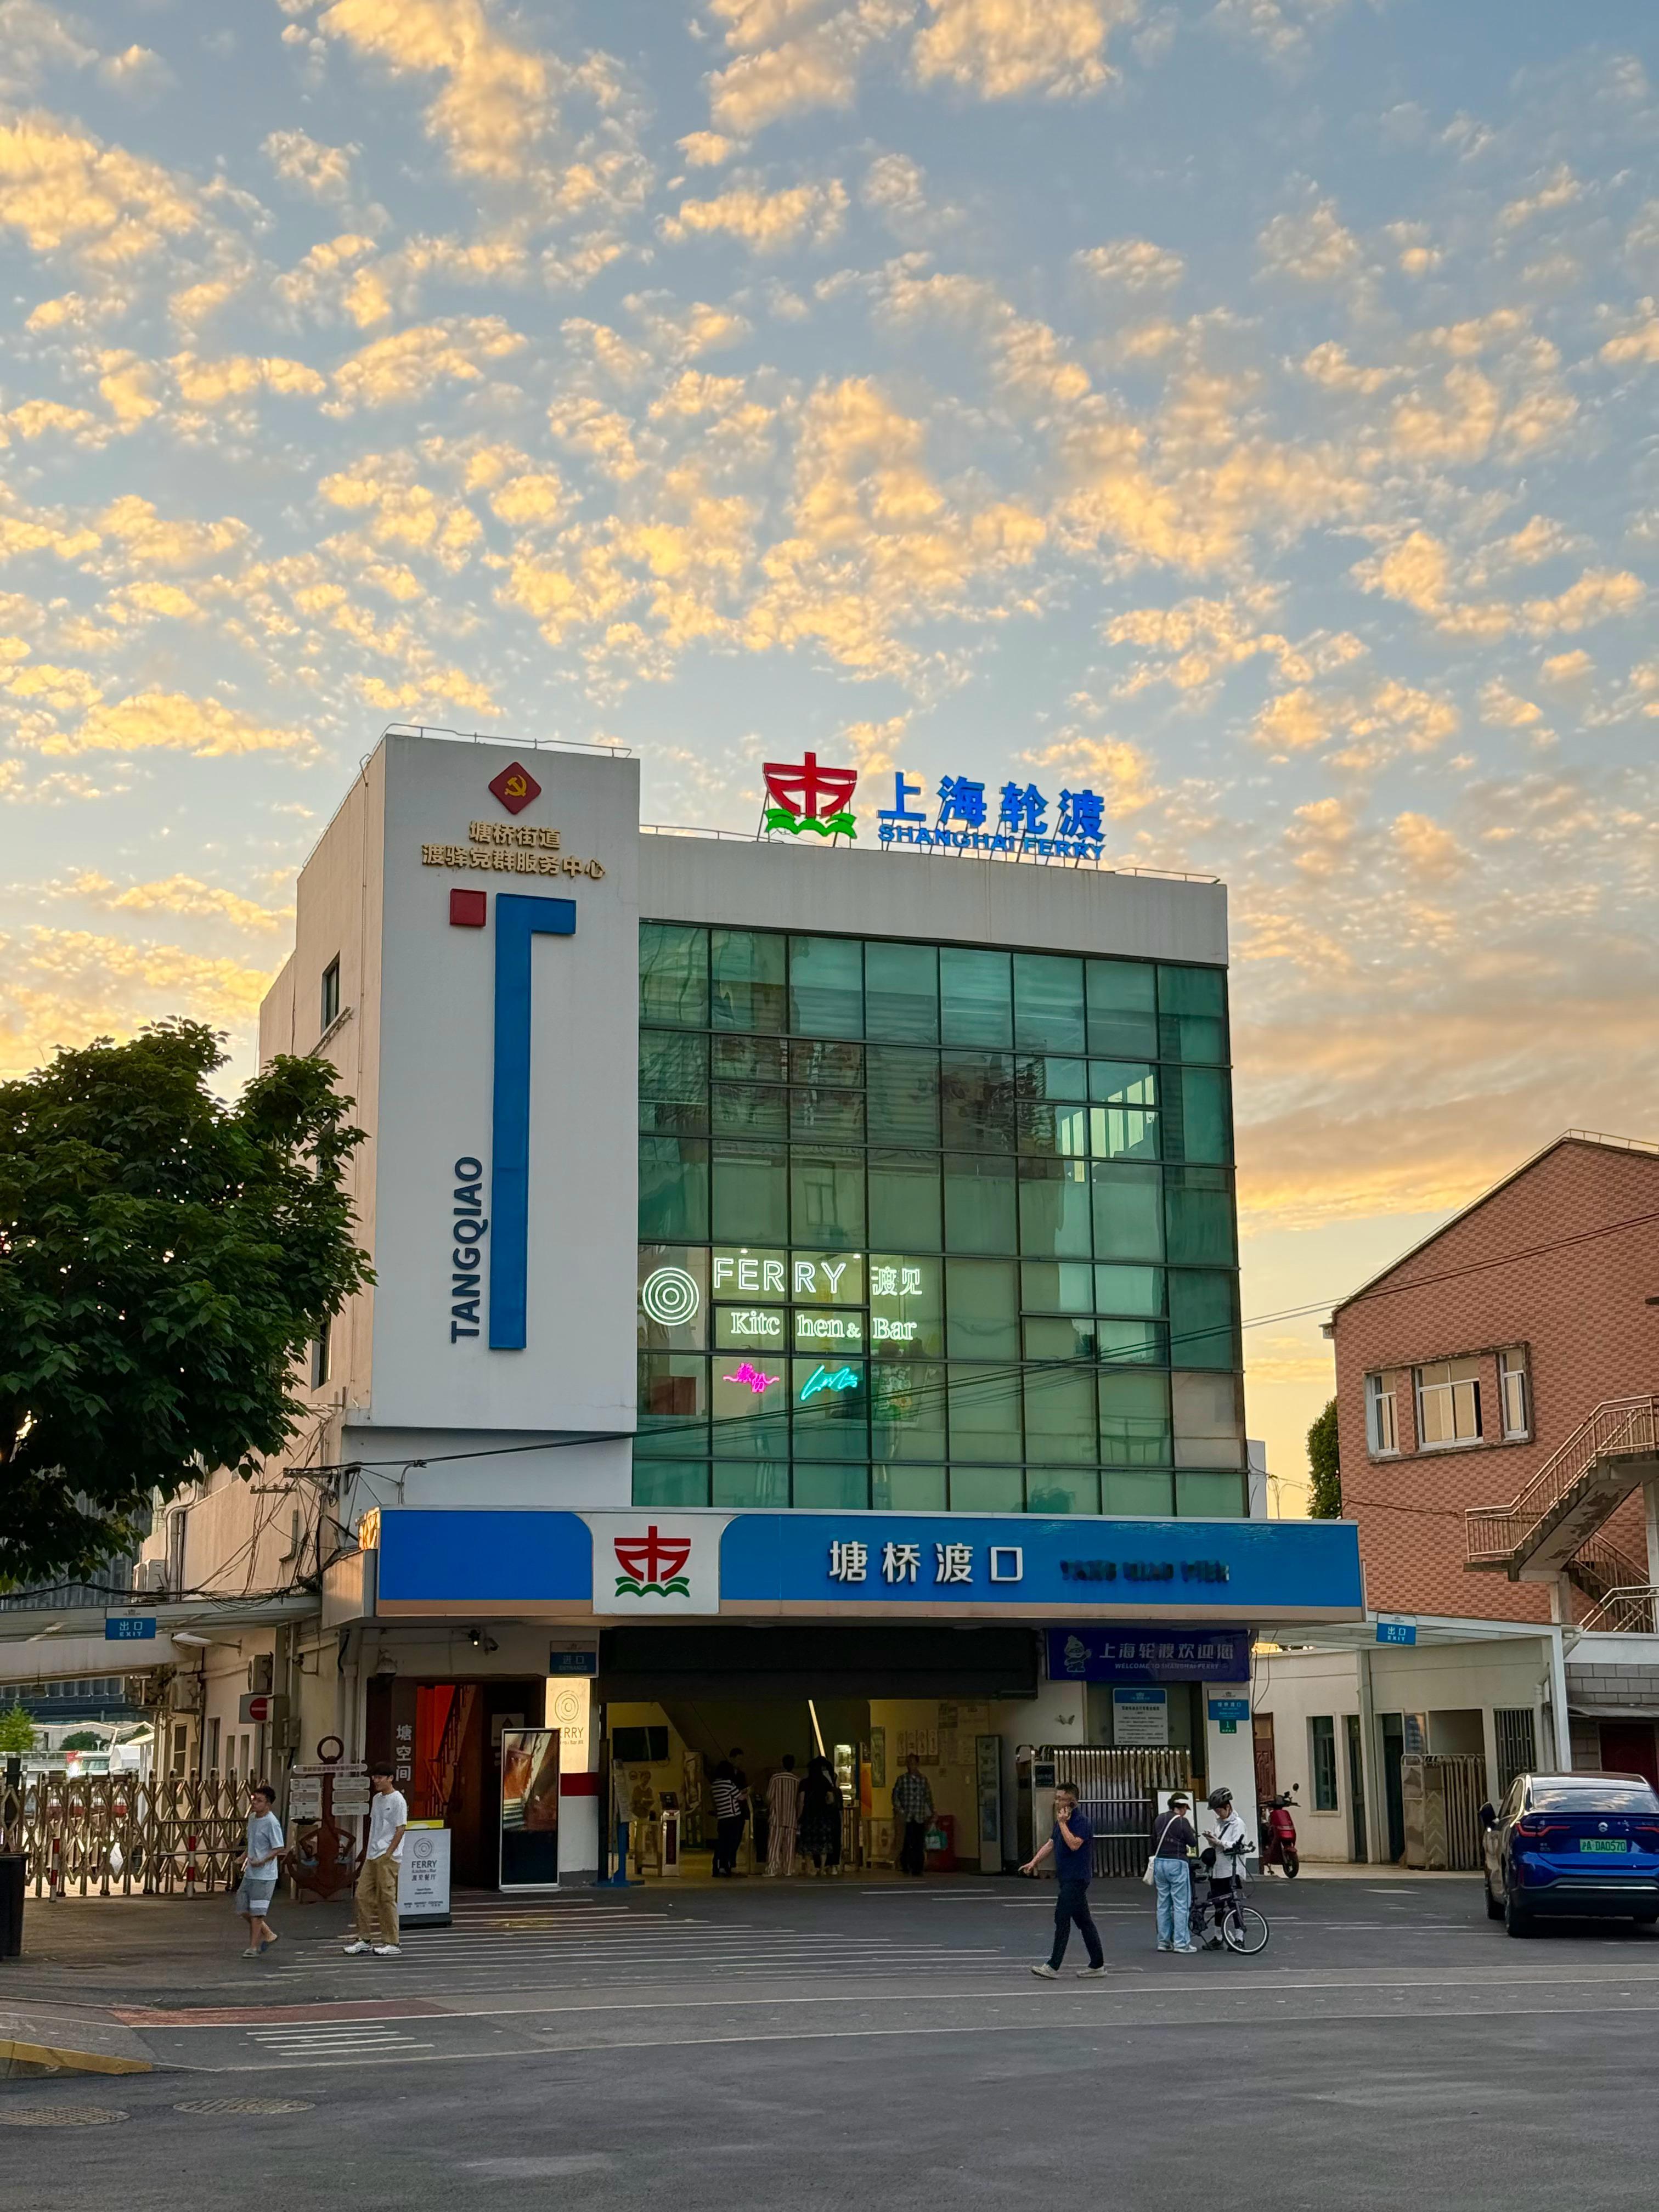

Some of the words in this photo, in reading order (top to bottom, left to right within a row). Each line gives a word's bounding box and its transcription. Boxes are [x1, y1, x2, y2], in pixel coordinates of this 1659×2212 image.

[877, 771, 1107, 841] 上海轮渡
[469, 821, 561, 849] 塘桥街道
[878, 824, 1015, 852] SHANGHAI
[1022, 837, 1106, 861] FERRY
[422, 844, 605, 879] 渡驿党群服务中心
[451, 1156, 488, 1344] TANGQIAO
[713, 1257, 847, 1294] FERRY
[871, 1265, 923, 1296] 渡见
[872, 1317, 917, 1341] Bar
[829, 1541, 1023, 1583] 塘桥渡口
[119, 1621, 143, 1631] 出口
[1387, 1627, 1406, 1635] 出口
[562, 1655, 585, 1665] 进口
[1099, 1643, 1234, 1660] 上海轮渡欢迎您
[411, 1860, 437, 1869] FERRY
